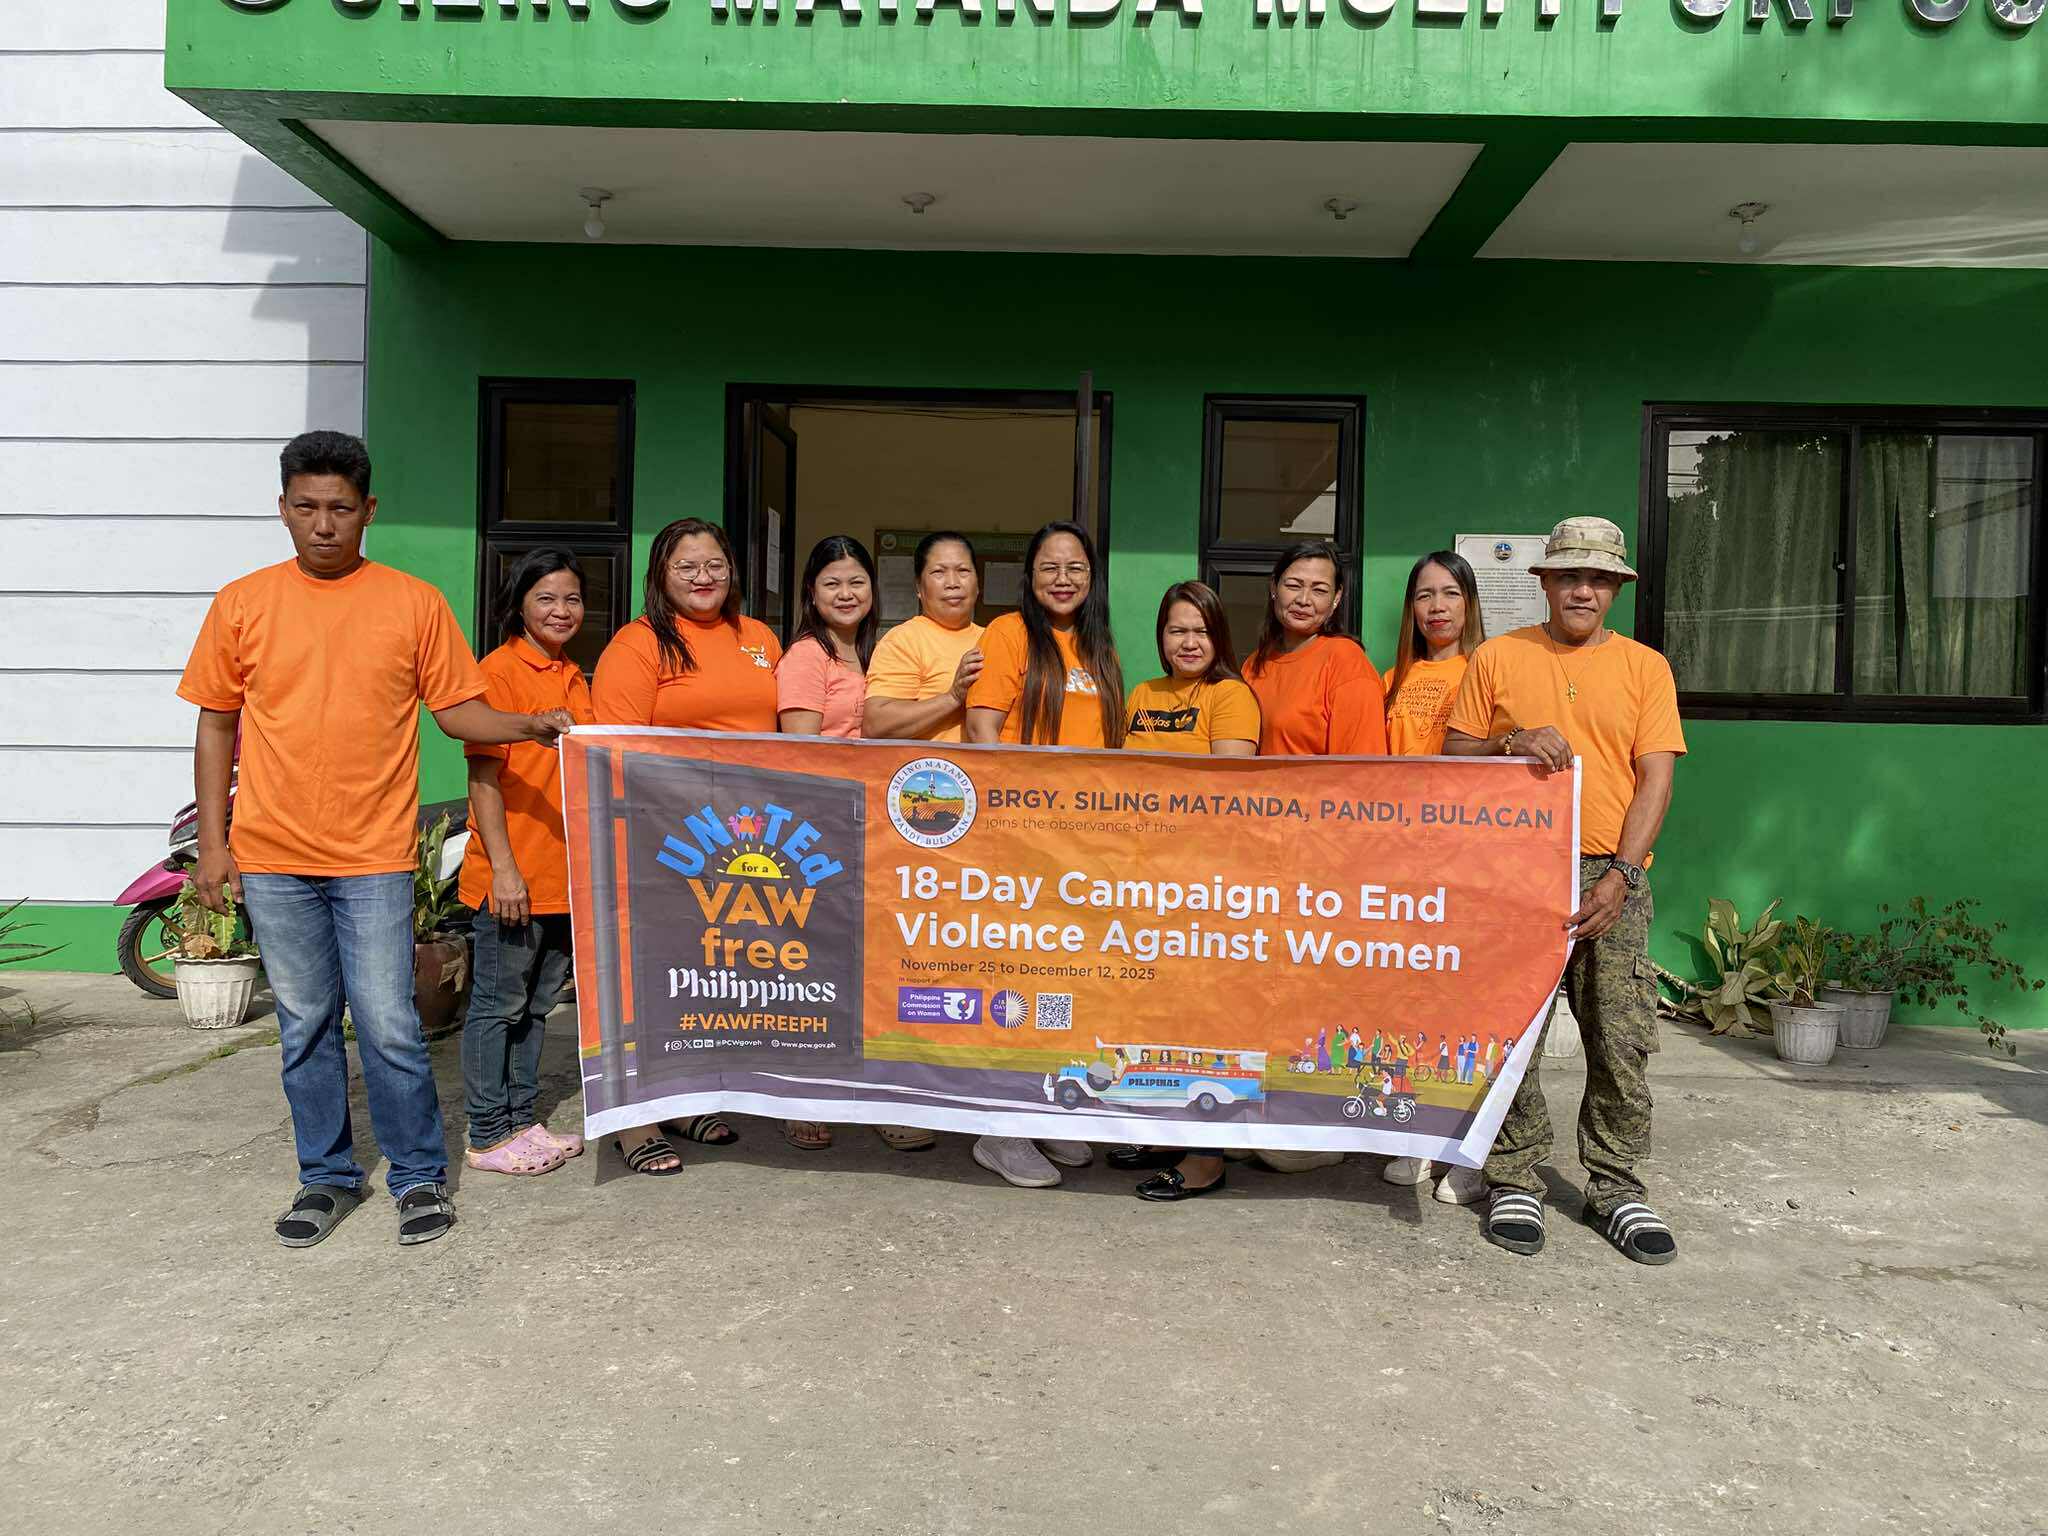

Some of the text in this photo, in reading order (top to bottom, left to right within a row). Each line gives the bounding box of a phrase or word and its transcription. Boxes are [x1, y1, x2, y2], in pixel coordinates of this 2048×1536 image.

[892, 760, 971, 794] SILING MATANDA
[985, 817, 1177, 834] joins the observance of the
[987, 789, 1553, 829] BRGY. SILING MATANDA, PANDI, BULACAN
[742, 862, 769, 874] for a
[685, 877, 816, 929] VAW
[895, 865, 1447, 922] 18-Day Campaign to End
[701, 928, 809, 970] free
[895, 910, 1461, 972] Violence Against Women
[668, 968, 836, 1007] Philippines
[901, 958, 1156, 981] November 25 to December 12, 2025
[680, 1013, 827, 1033] #VAWFREEPH
[1128, 1078, 1180, 1088] PILIPINAS
